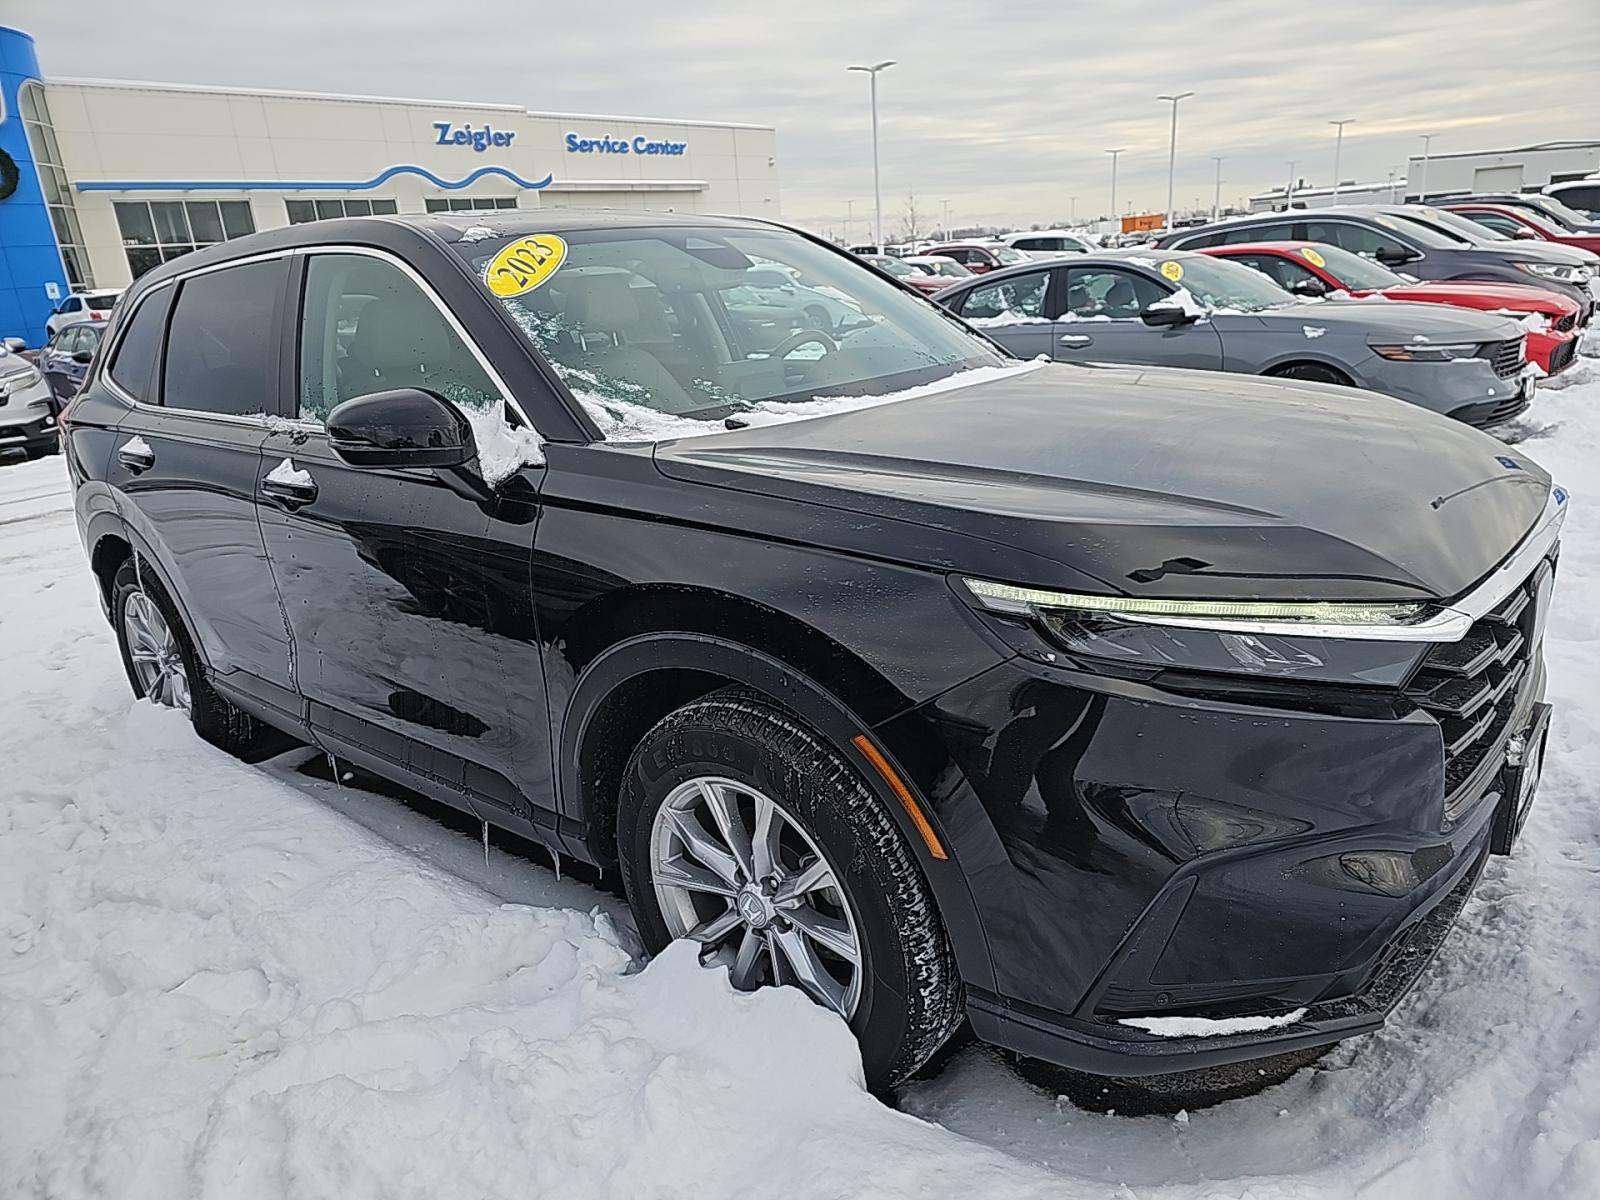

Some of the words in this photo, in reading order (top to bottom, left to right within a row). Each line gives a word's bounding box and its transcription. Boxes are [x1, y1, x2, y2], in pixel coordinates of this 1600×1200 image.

[433, 122, 516, 152] Zeigler
[566, 134, 630, 154] Service
[633, 137, 687, 155] Center
[497, 240, 554, 288] 2023
